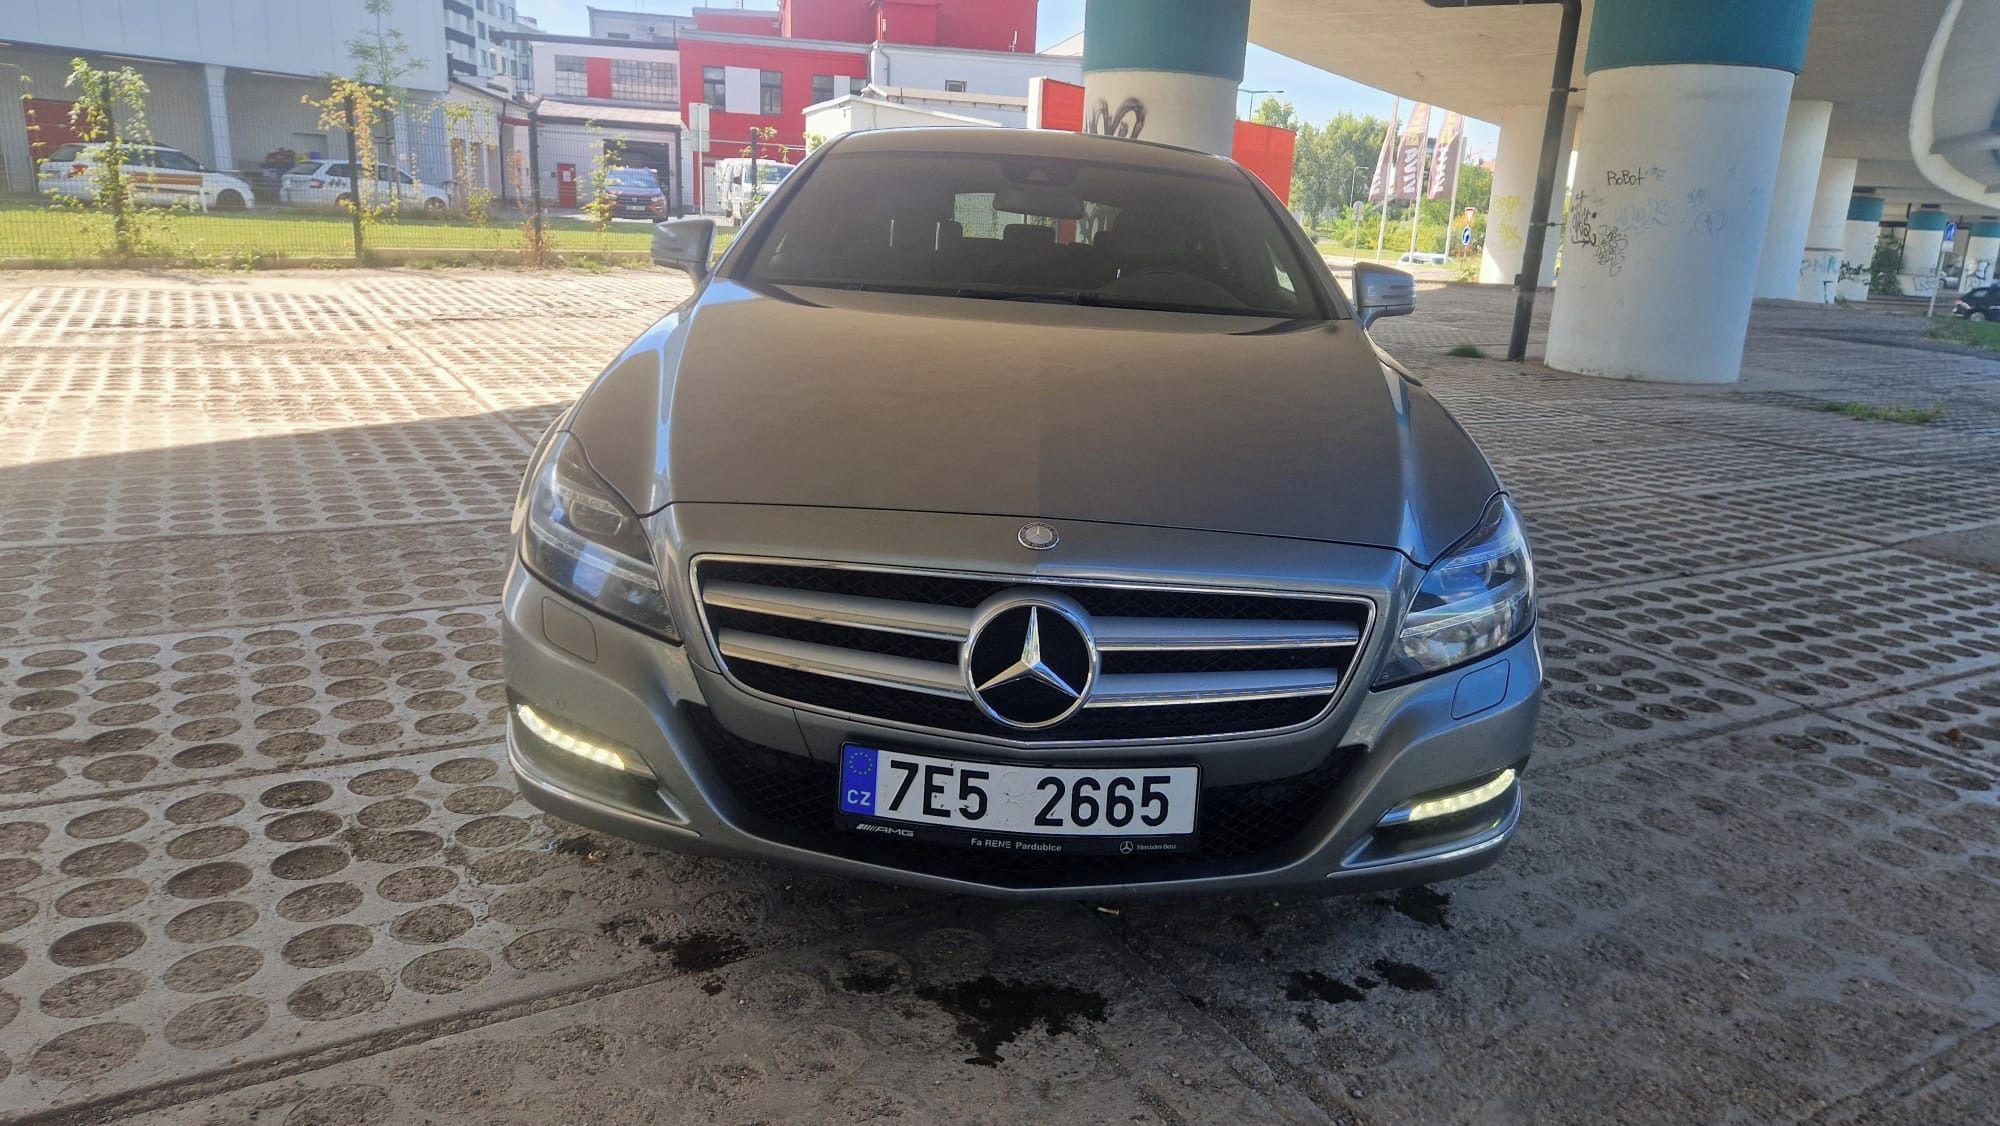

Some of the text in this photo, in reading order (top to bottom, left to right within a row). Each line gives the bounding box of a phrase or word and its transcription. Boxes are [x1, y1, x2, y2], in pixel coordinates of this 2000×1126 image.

[846, 788, 872, 807] CZ
[888, 759, 1172, 828] 7E5 2665
[970, 837, 983, 847] Fa
[1015, 841, 1063, 852] Pardubice
